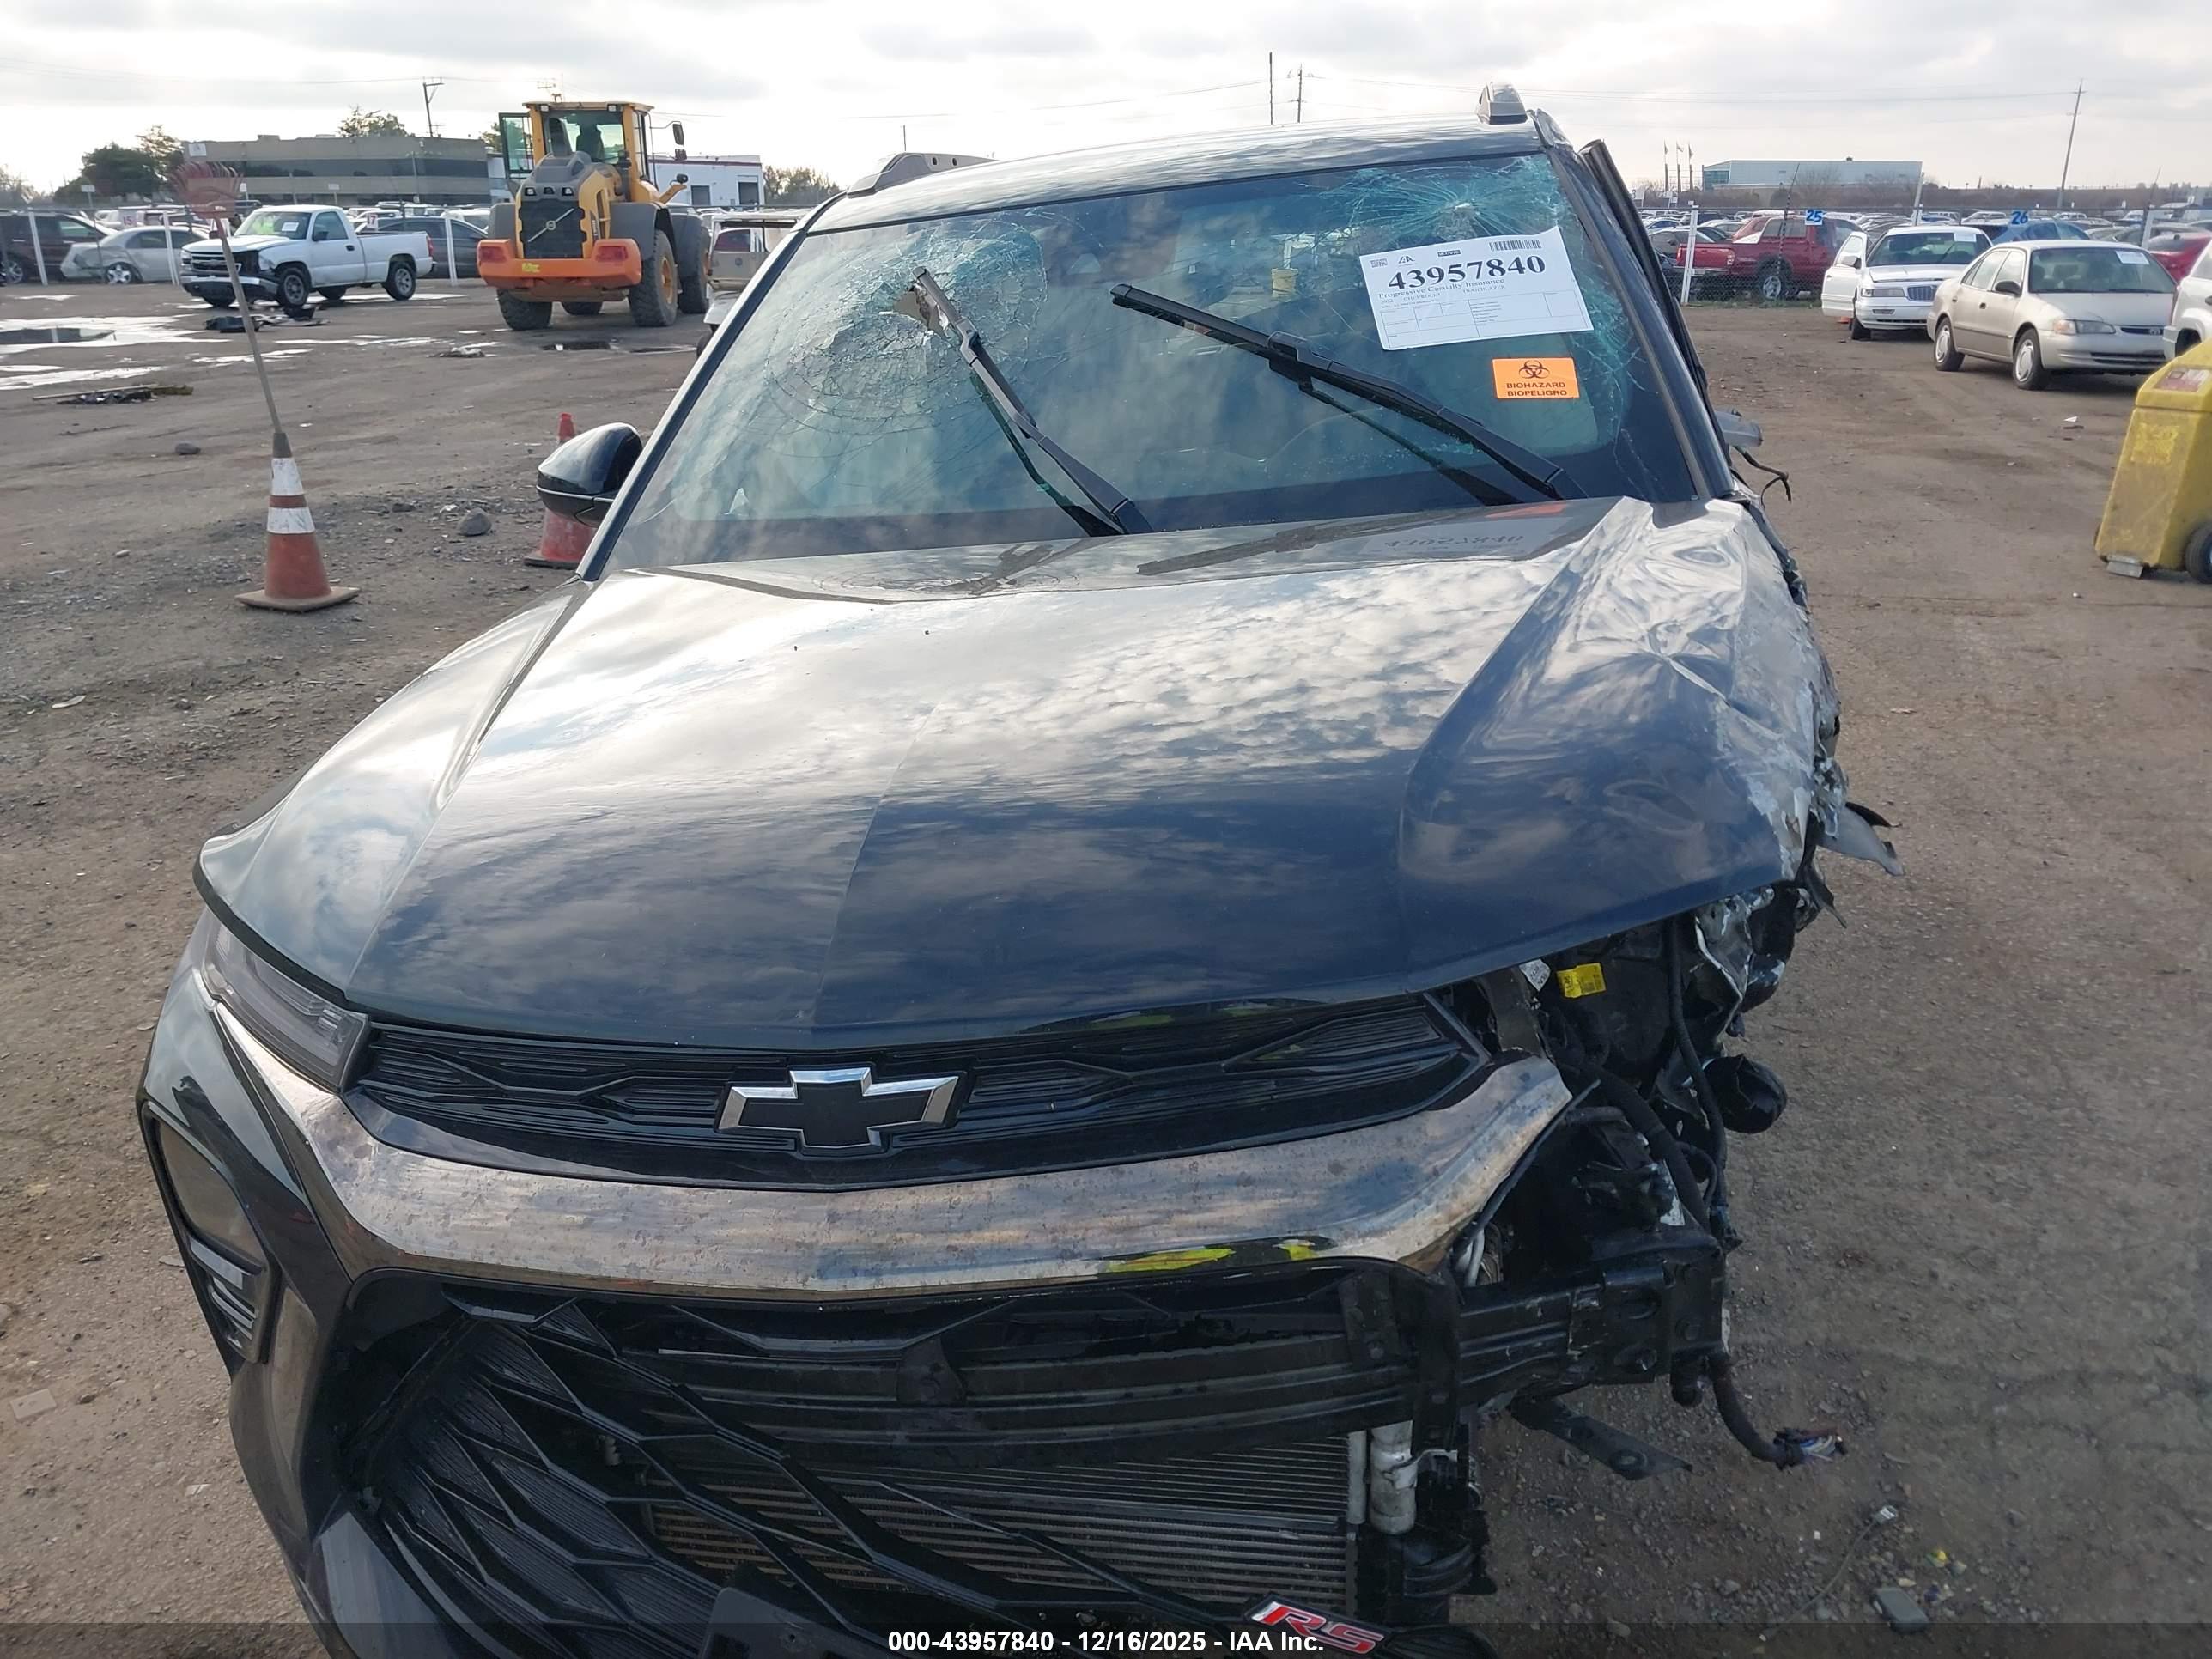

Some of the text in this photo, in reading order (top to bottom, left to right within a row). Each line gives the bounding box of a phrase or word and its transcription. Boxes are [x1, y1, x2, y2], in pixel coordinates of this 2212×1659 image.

[1806, 209, 1825, 222] 25
[2011, 210, 2029, 225] 26
[1389, 255, 1546, 289] 43957840
[1378, 278, 1504, 299] Progressive Casualty Insurance
[1251, 1601, 1385, 1655] RS
